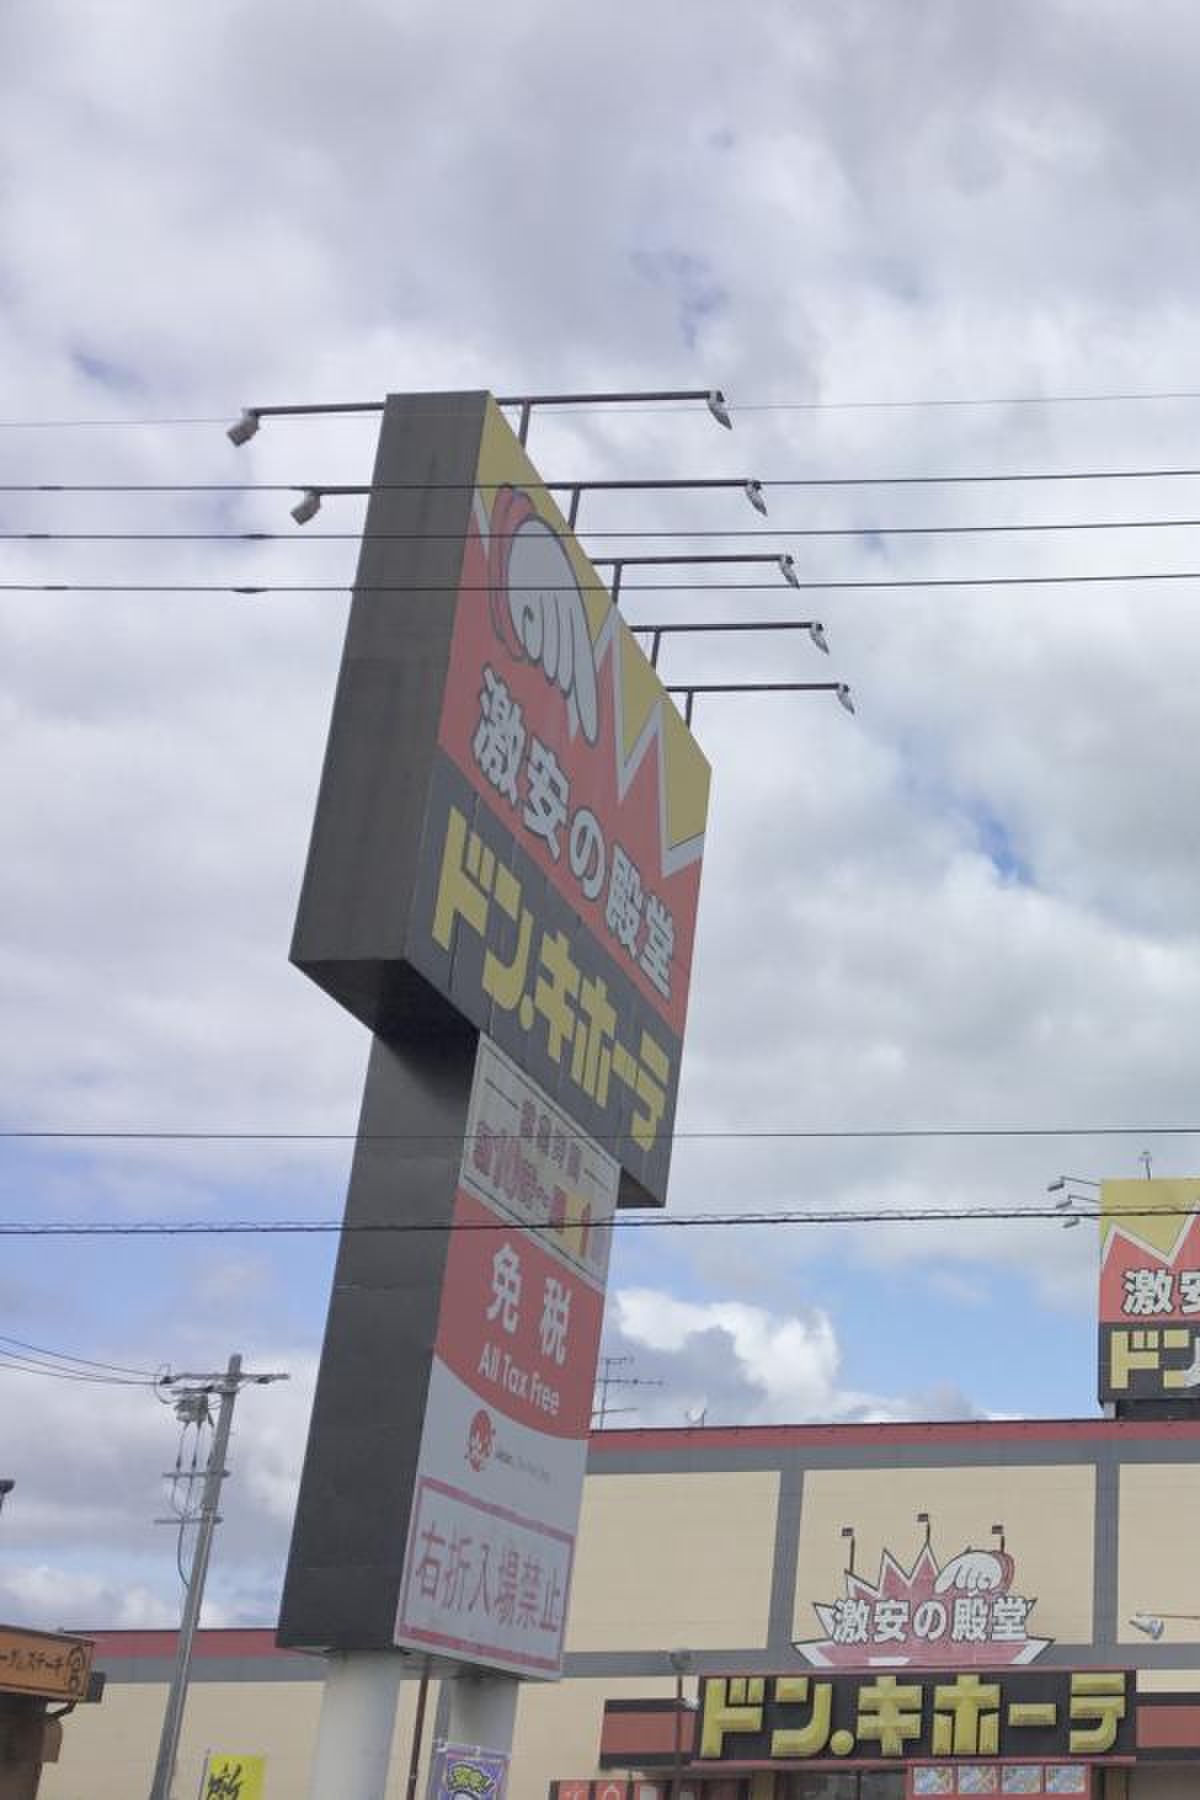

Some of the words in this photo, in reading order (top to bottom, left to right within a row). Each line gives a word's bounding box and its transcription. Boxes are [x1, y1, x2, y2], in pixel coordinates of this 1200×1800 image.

[472, 661, 677, 1002] 激安の殿堂
[486, 1243, 572, 1367] 免税
[477, 1342, 500, 1381] All
[503, 1353, 529, 1399] Tax
[530, 1371, 561, 1417] Free
[415, 1519, 561, 1633] 右折入場禁止
[831, 1597, 1030, 1645] 激安の殿堂
